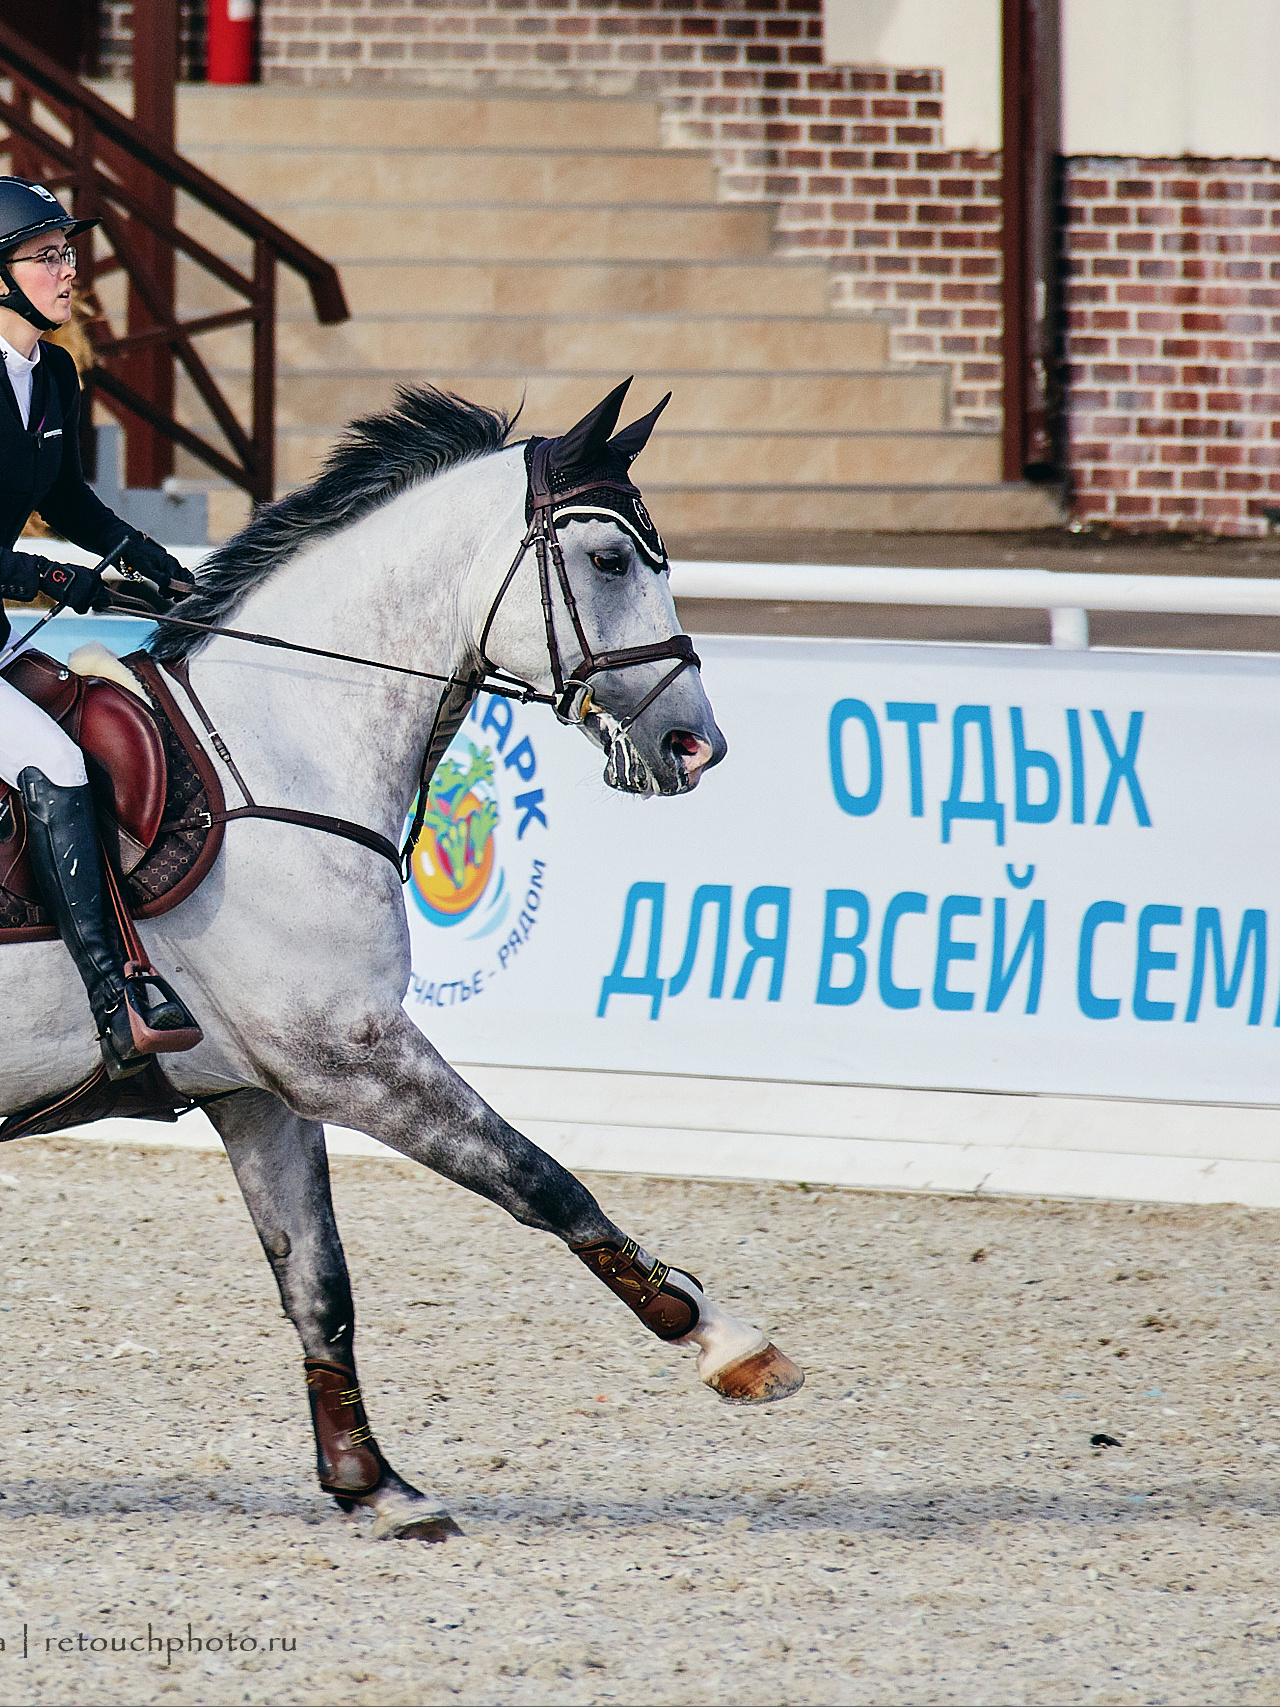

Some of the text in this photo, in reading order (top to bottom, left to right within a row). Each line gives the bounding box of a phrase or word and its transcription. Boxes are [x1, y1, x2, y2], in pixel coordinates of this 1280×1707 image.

[471, 693, 548, 841] АРК
[828, 698, 1153, 846] ОТДЫХ
[410, 969, 483, 1007] ЧАСТЬЕ
[497, 859, 547, 969] РЯДОМ
[596, 864, 1280, 1028] ДЛЯ ВСЕЙ СЕМ
